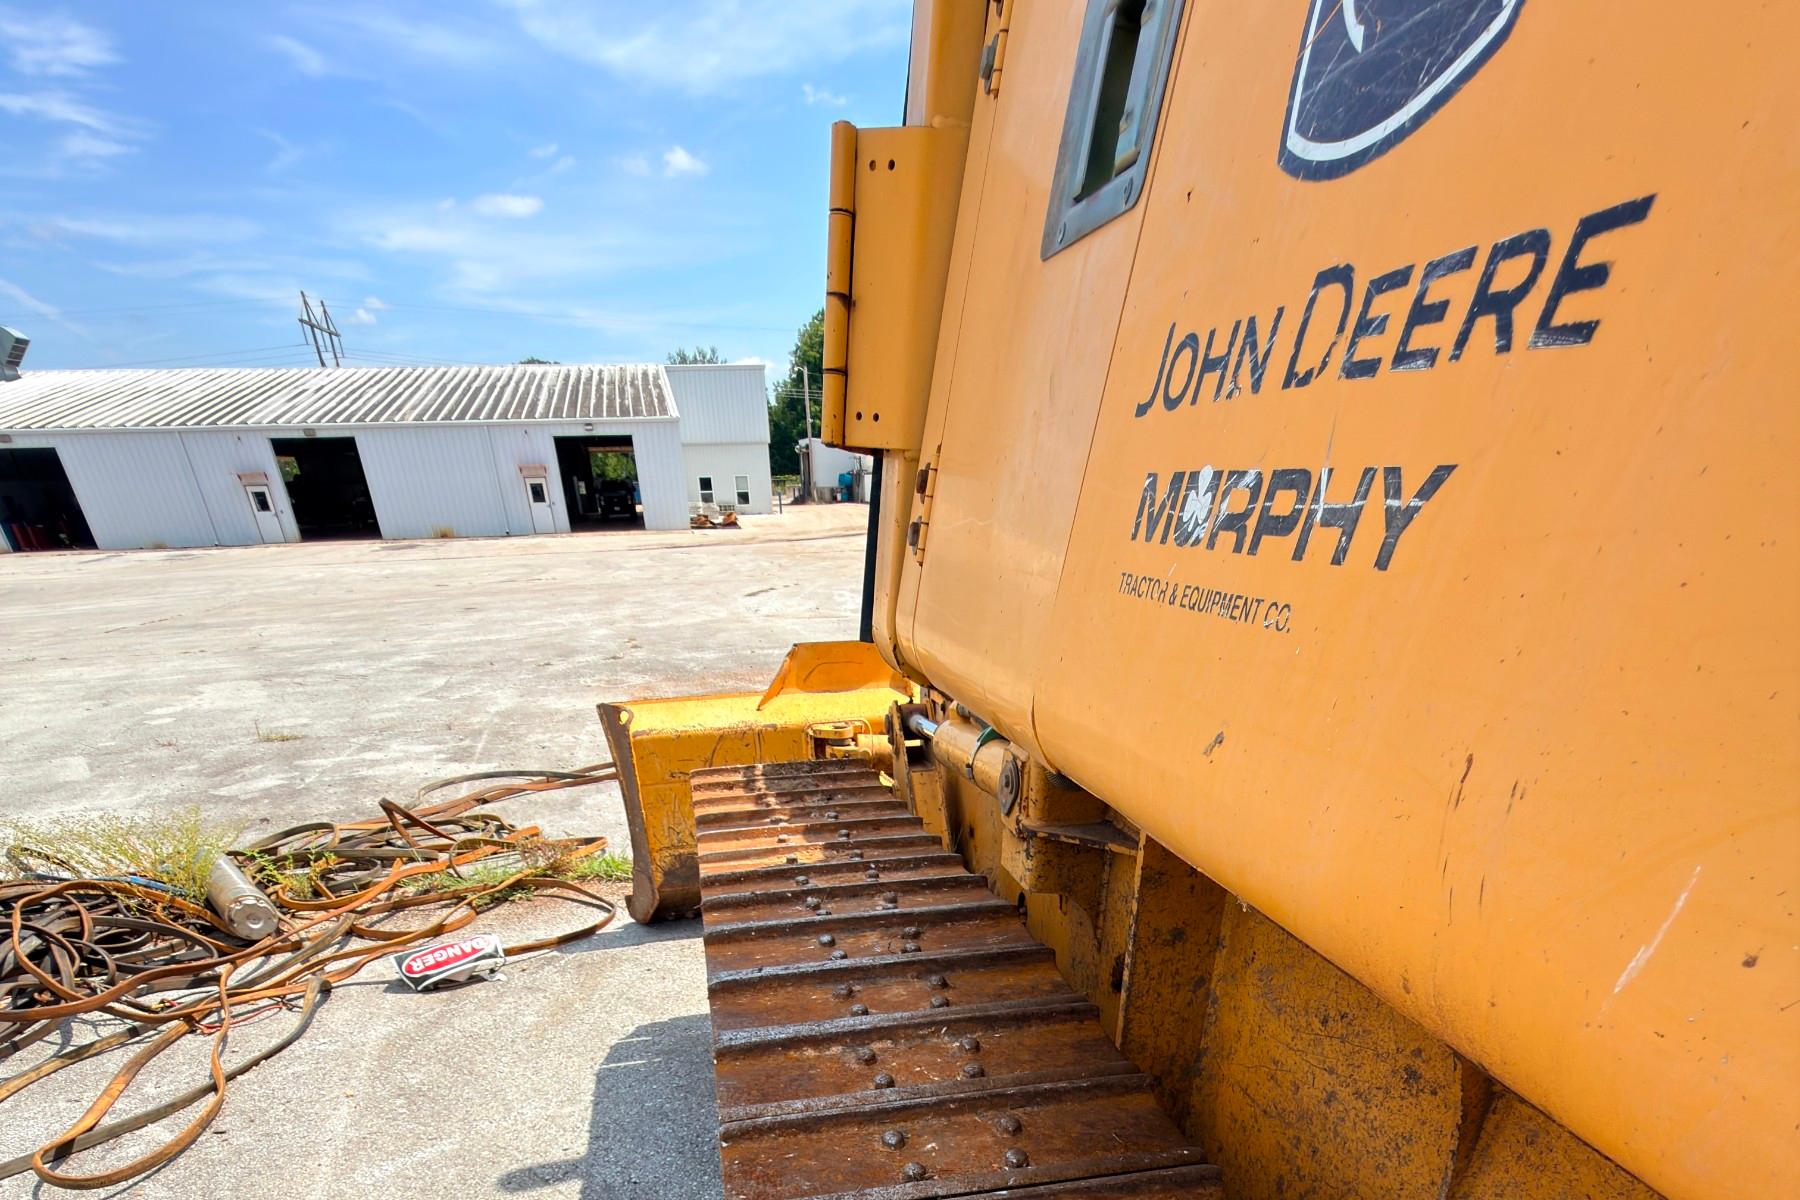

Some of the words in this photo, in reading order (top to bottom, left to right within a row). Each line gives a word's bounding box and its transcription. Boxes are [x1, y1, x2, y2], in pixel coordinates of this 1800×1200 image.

[1134, 306, 1284, 418] JOHN
[1281, 193, 1657, 390] DEERE
[1131, 464, 1458, 572] MURPHY
[1118, 572, 1169, 604] TRACTOR
[1168, 583, 1179, 606] &
[1179, 584, 1264, 625] EQUIPMENT
[410, 936, 489, 972] DANGER
